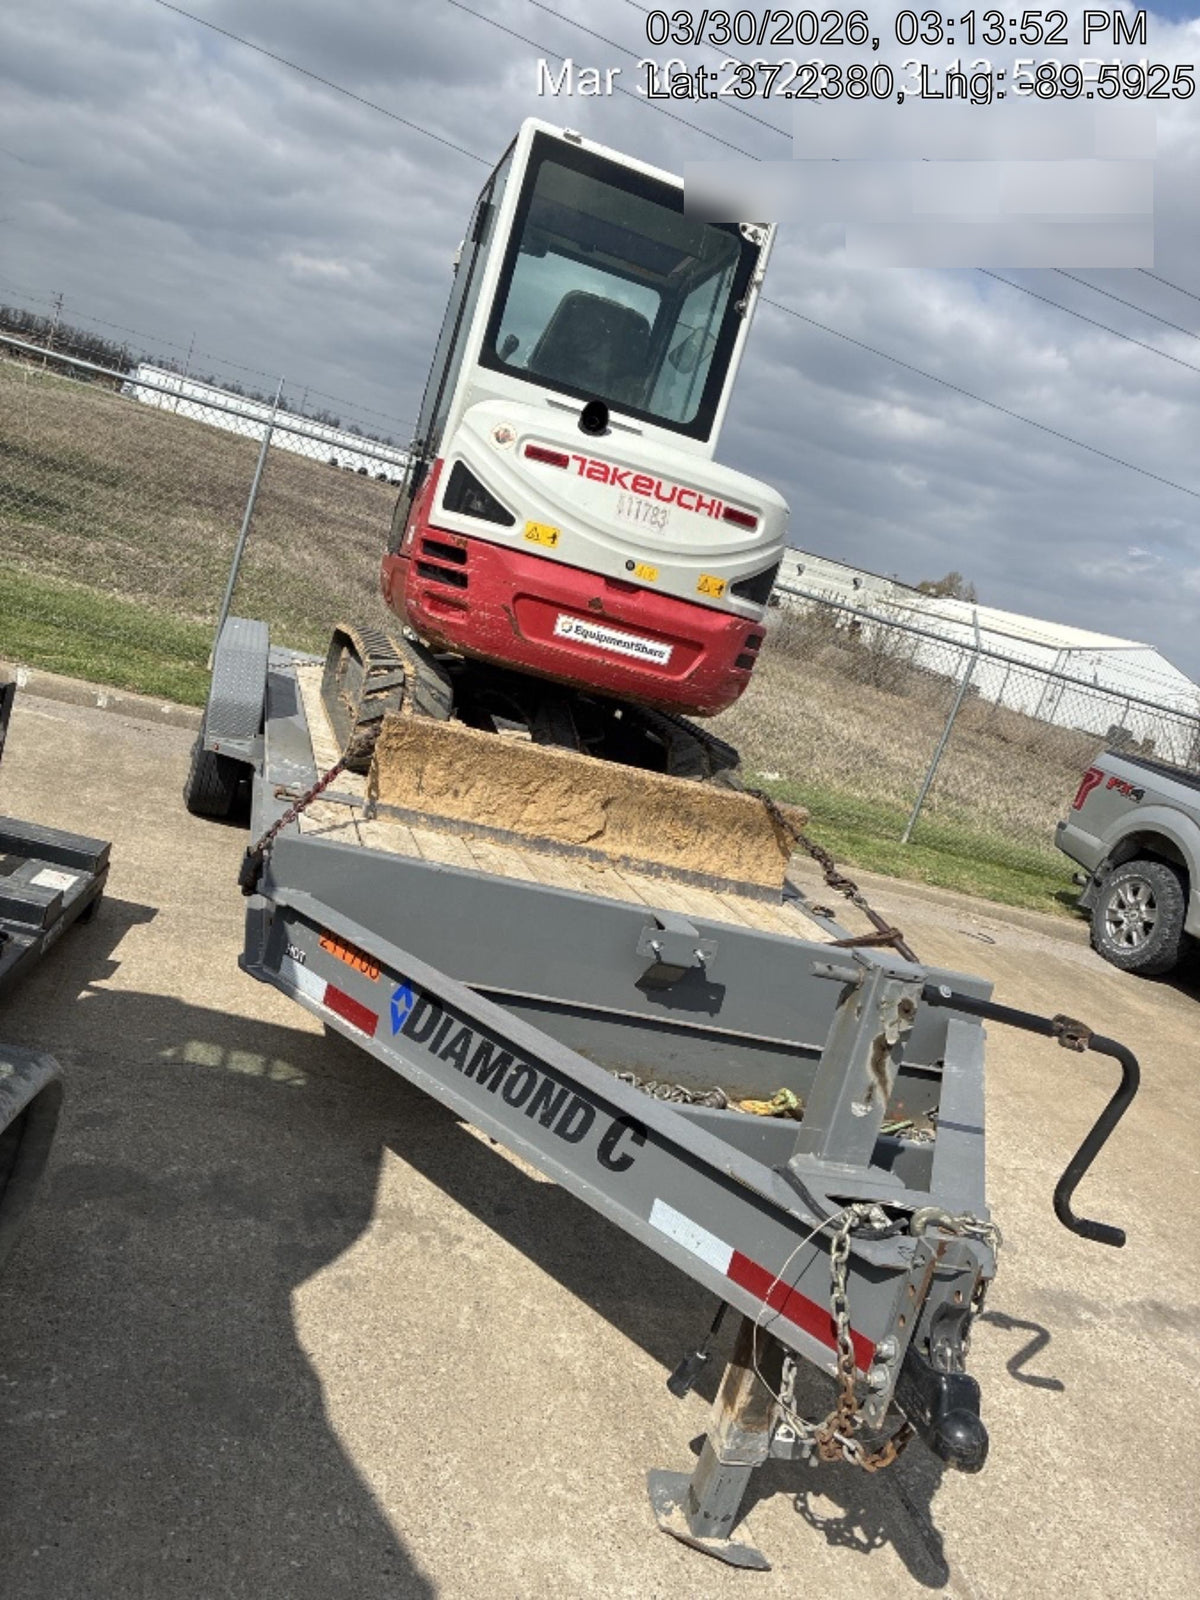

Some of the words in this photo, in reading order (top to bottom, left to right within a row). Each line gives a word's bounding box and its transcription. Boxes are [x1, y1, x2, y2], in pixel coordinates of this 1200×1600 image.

[573, 625, 666, 659] EquipmentShare
[401, 990, 597, 1145] DIAMOND
[596, 1114, 649, 1173] C
